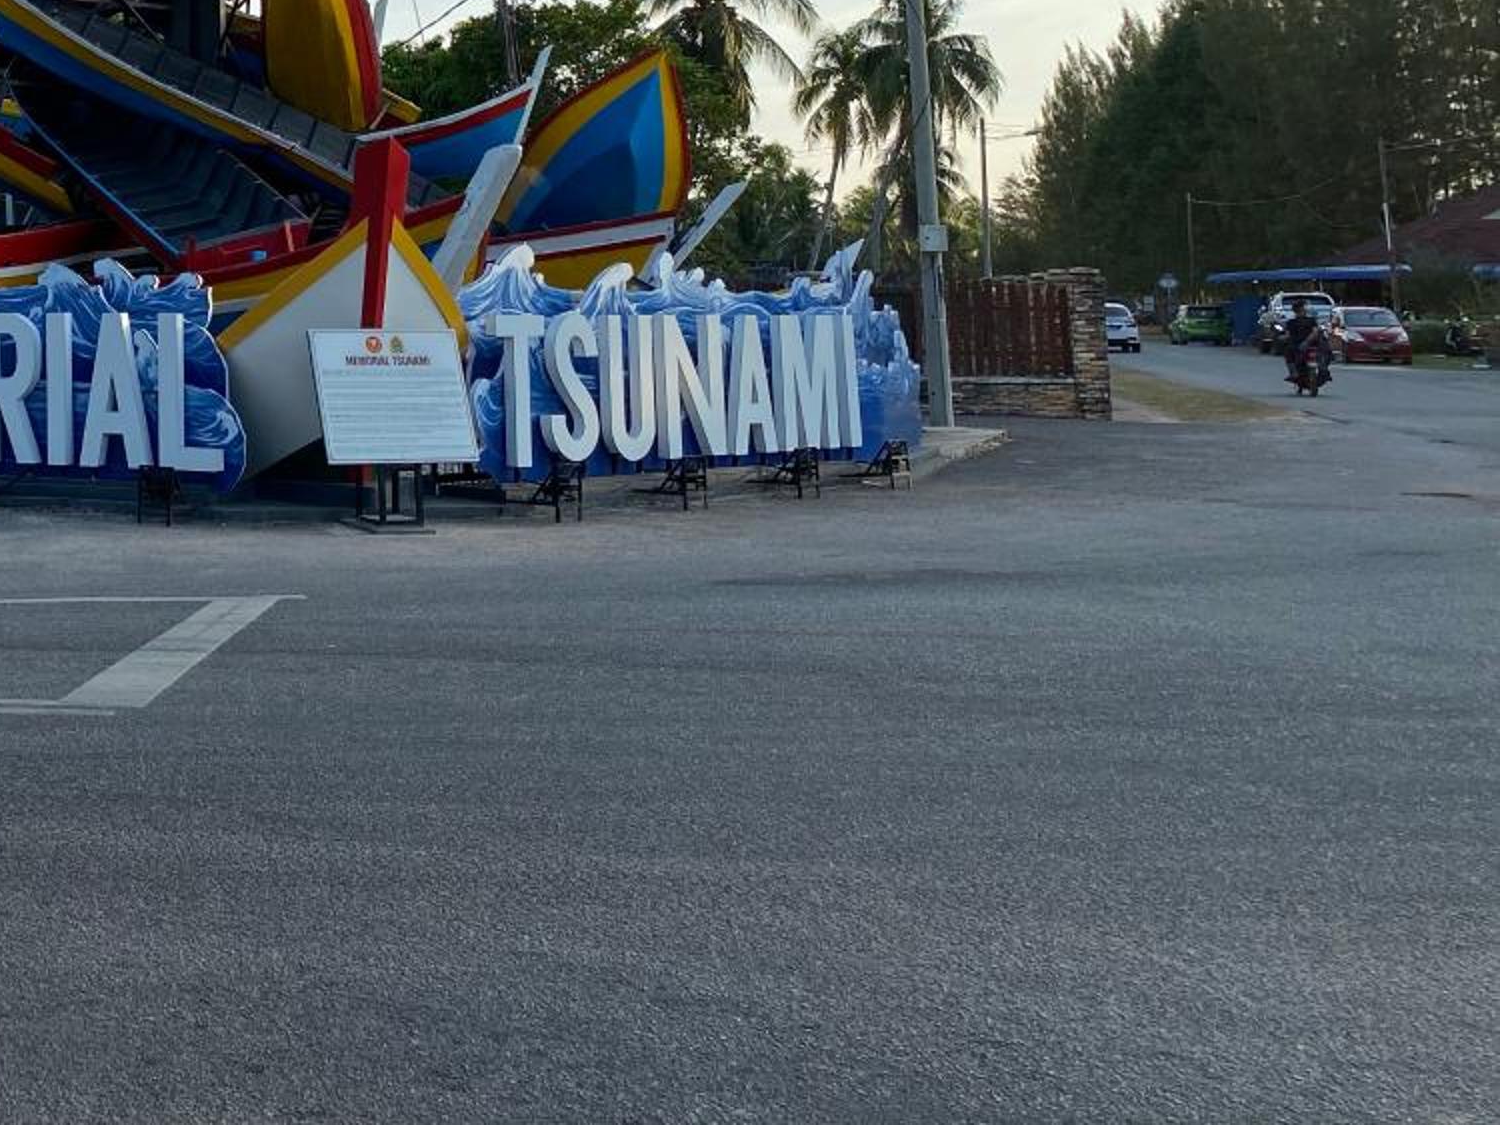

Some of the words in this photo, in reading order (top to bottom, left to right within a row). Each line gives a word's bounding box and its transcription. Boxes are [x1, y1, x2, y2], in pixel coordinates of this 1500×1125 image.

[346, 355, 389, 366] MEMORIAL
[392, 355, 431, 366] TSUNAMI
[487, 313, 863, 469] TSUNAMI
